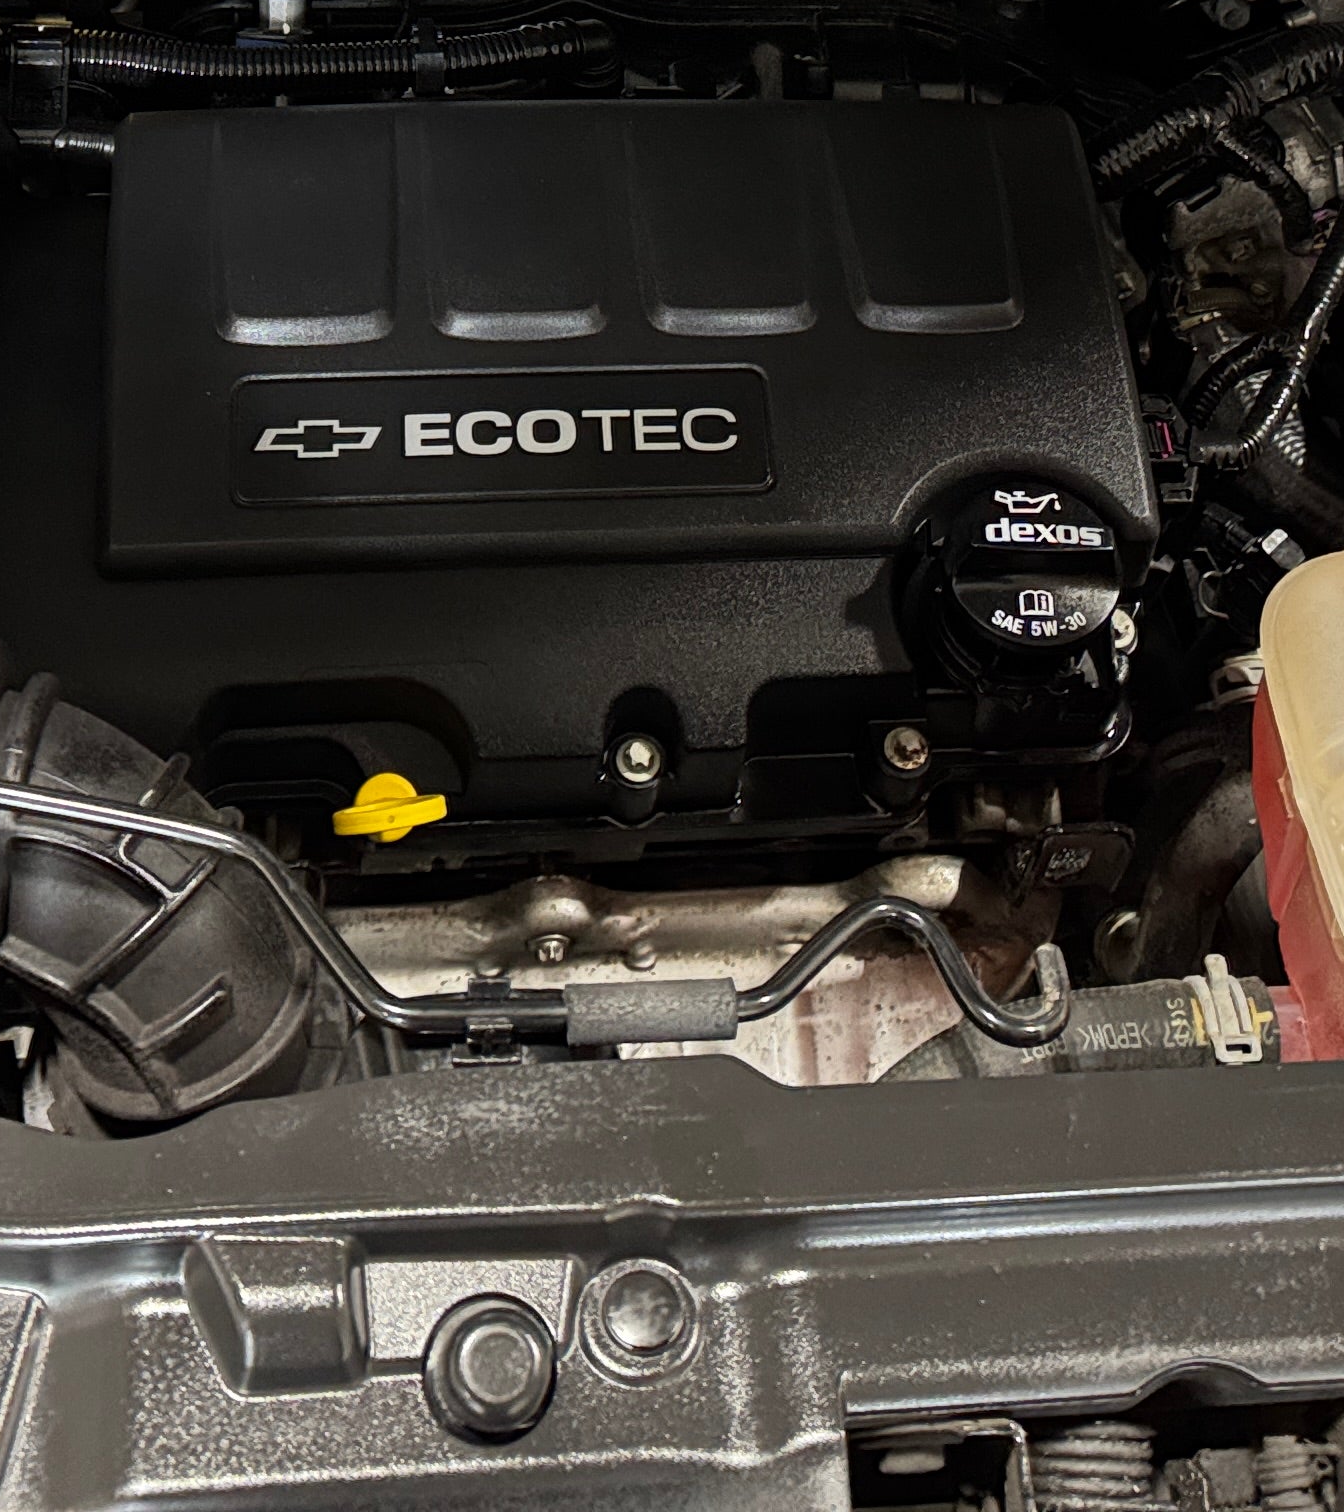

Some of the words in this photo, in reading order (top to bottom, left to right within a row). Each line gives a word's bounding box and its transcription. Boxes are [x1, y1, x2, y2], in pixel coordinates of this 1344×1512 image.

[404, 408, 738, 456] ECOTEC
[985, 517, 1105, 547] dexos
[991, 609, 1024, 635] SAE
[1030, 611, 1087, 637] 5W-30
